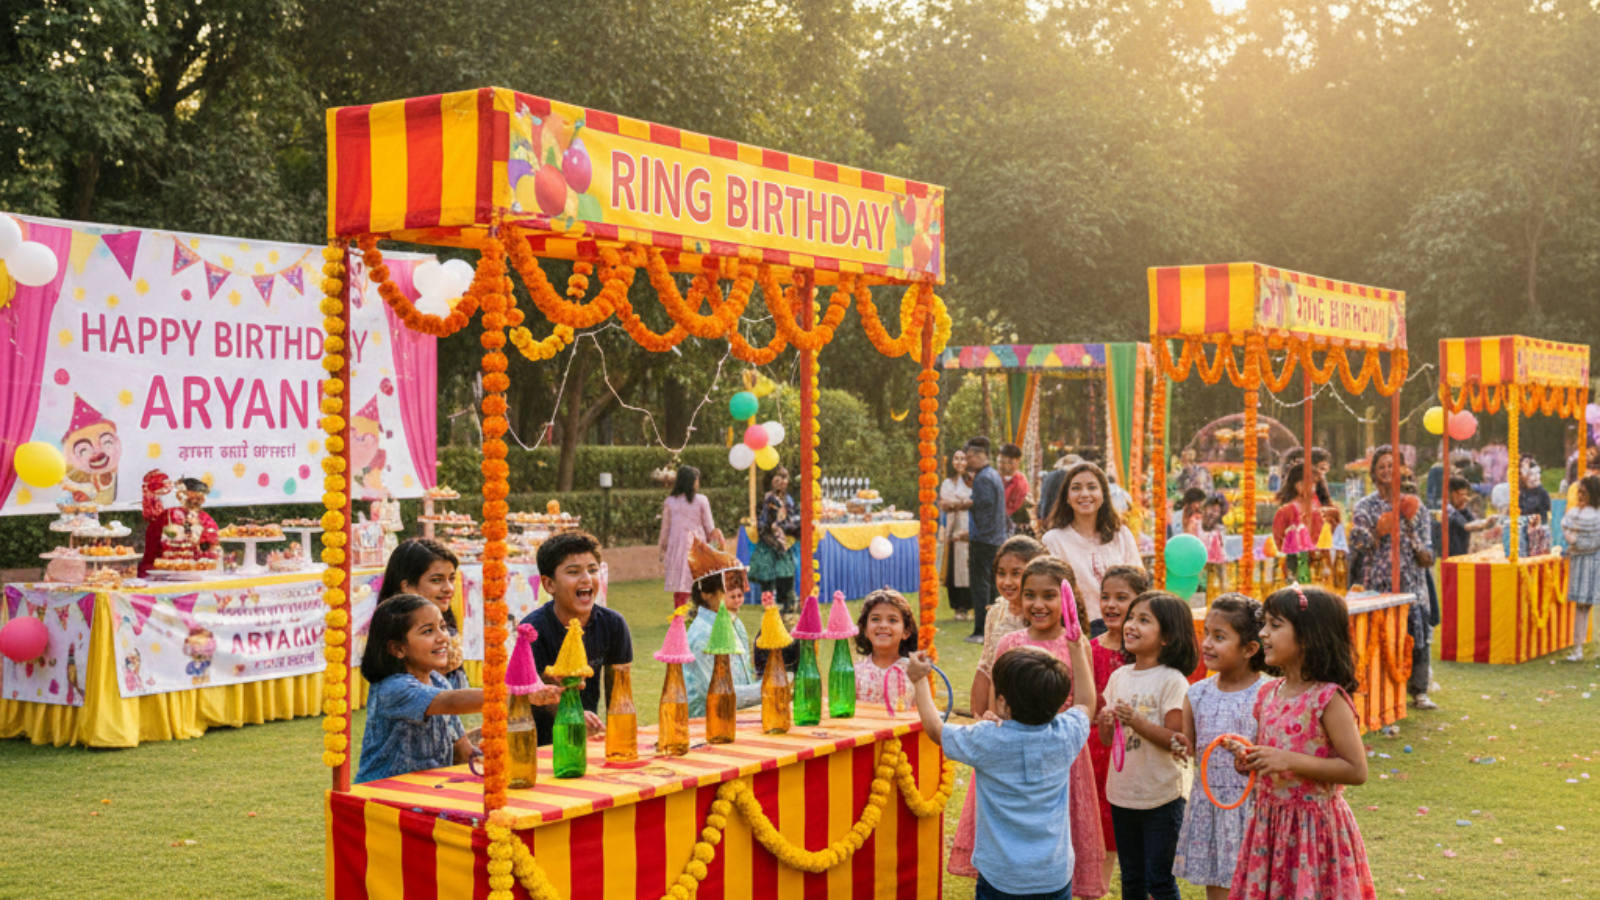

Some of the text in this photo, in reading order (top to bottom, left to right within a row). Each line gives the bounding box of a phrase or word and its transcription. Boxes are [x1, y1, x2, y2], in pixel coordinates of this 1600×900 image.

[611, 150, 890, 251] RING BIRTHDAY
[81, 312, 368, 363] HAPPY BIRTHDY
